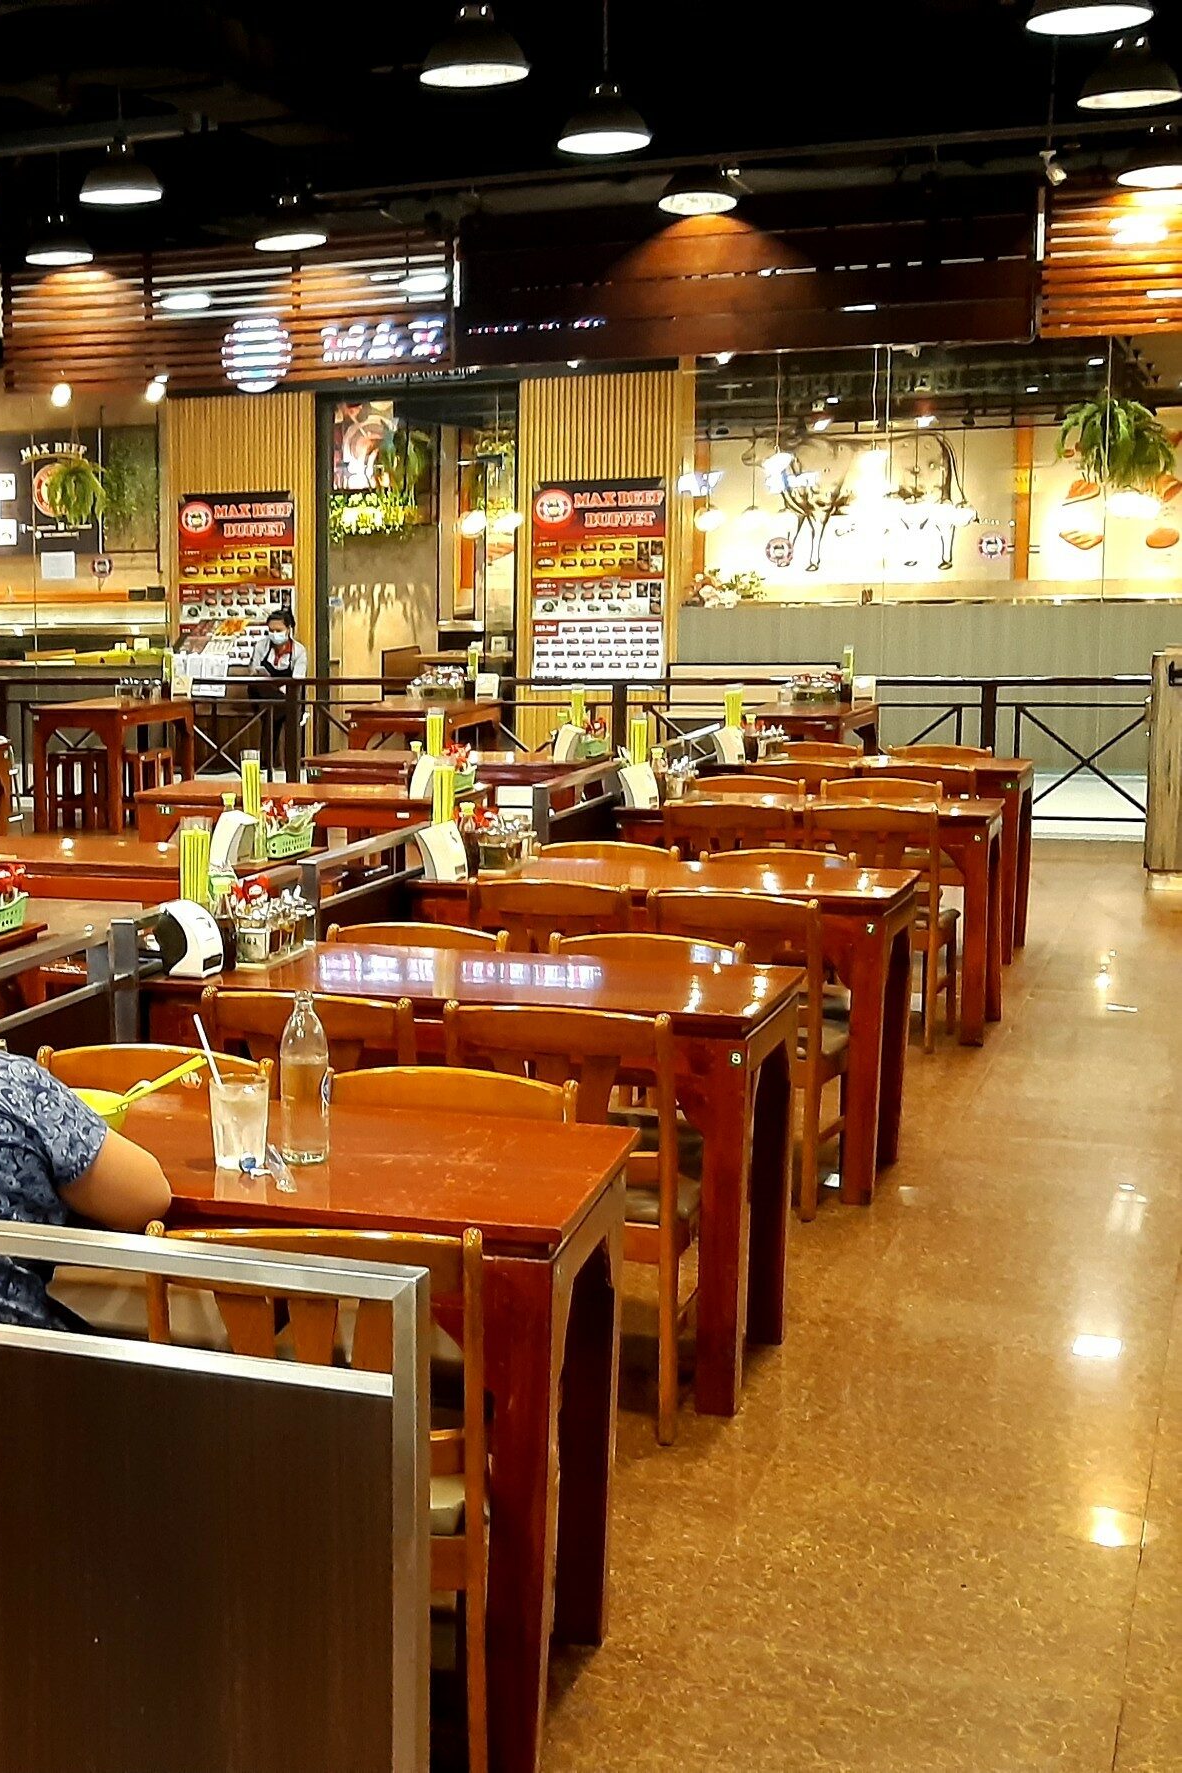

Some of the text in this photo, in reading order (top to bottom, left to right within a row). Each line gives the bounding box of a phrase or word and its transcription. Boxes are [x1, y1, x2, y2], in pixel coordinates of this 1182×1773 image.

[20, 442, 50, 462] MAX
[573, 491, 617, 508] MAX
[213, 504, 252, 520] MAX
[584, 511, 656, 528] BUFFET
[866, 923, 874, 934] 7
[731, 1052, 742, 1065] 8
